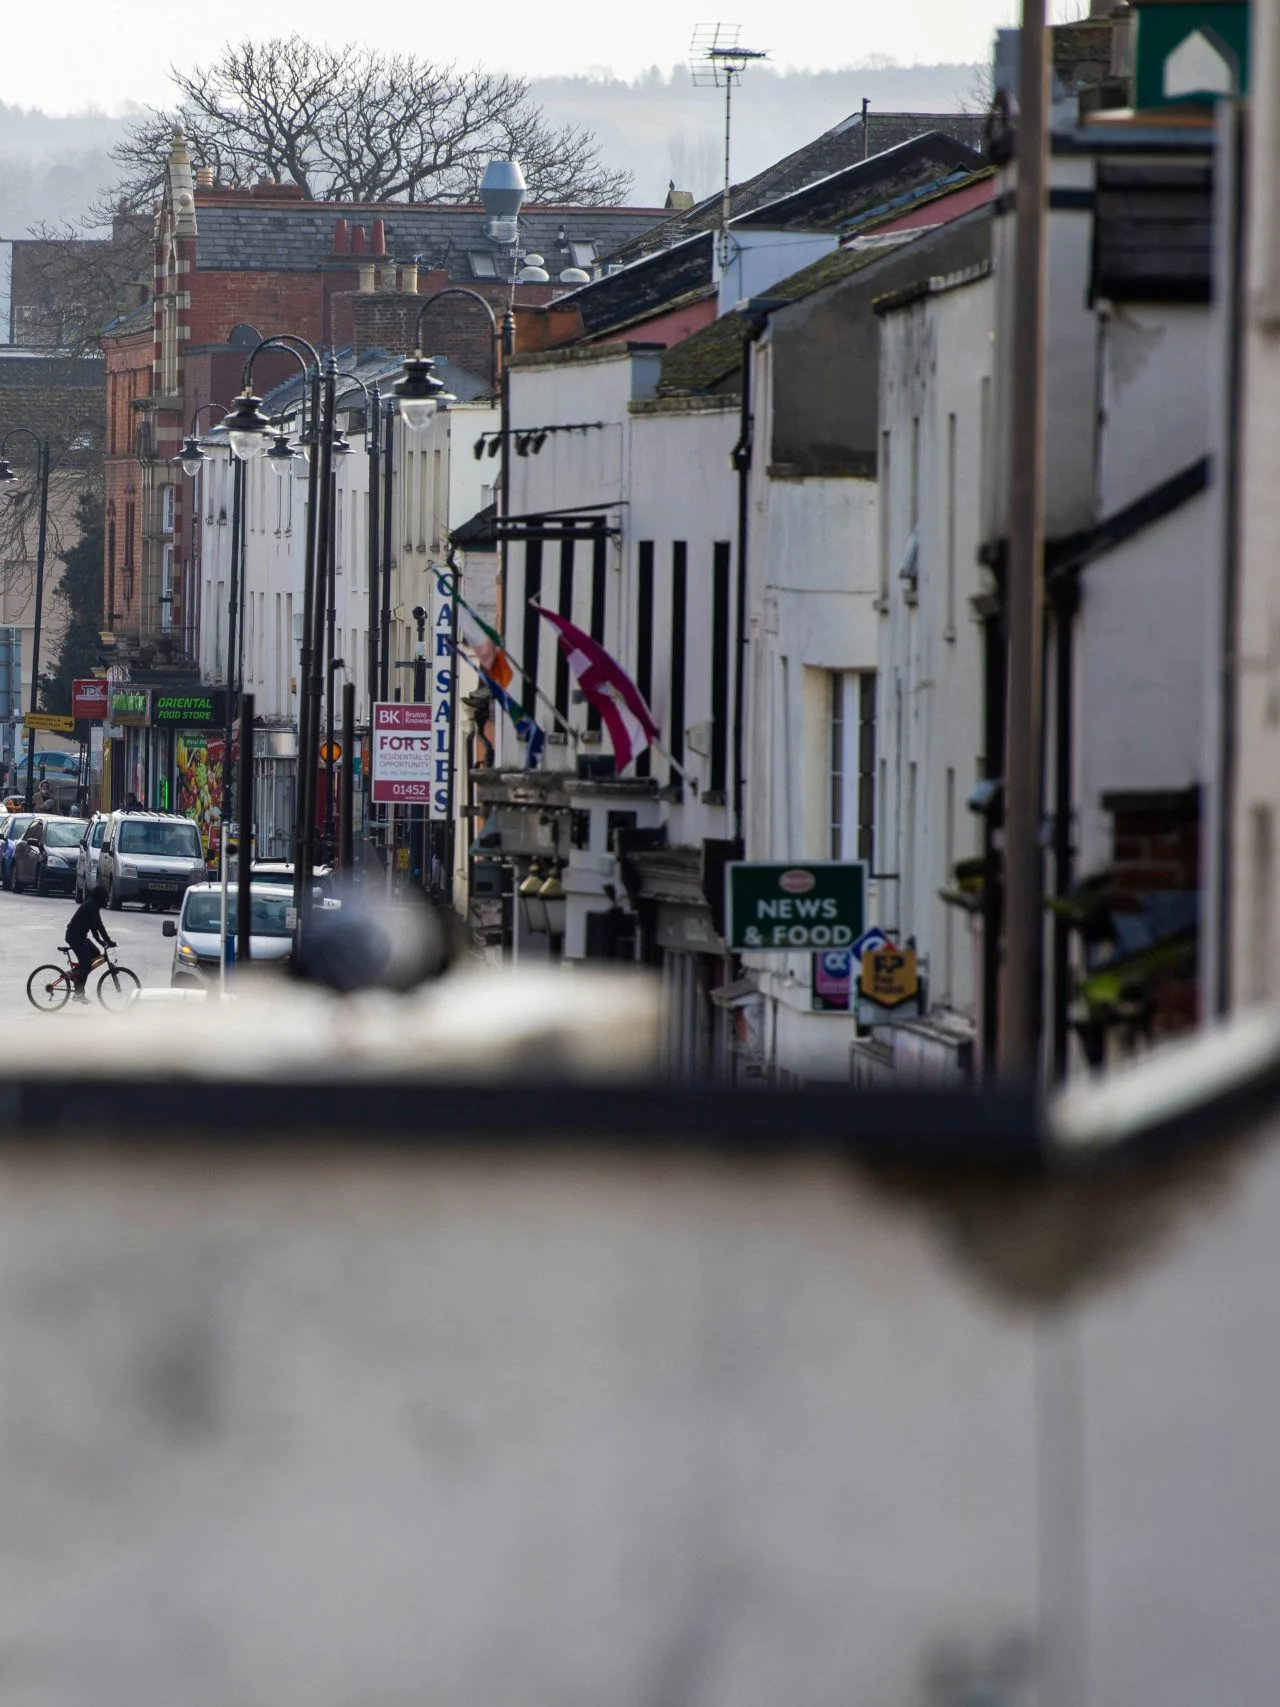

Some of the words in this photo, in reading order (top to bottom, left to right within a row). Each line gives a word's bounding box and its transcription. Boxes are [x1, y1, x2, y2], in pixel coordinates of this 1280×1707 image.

[157, 698, 213, 708] ORIENTAL
[158, 711, 180, 719] FOOD
[182, 711, 212, 719] STORE
[379, 710, 400, 724] BK
[380, 736, 415, 750] FOR
[434, 669, 452, 813] SALES
[393, 784, 426, 795] 01452
[757, 898, 838, 919] NEWS
[744, 926, 762, 945] &
[773, 925, 852, 945] FOOD
